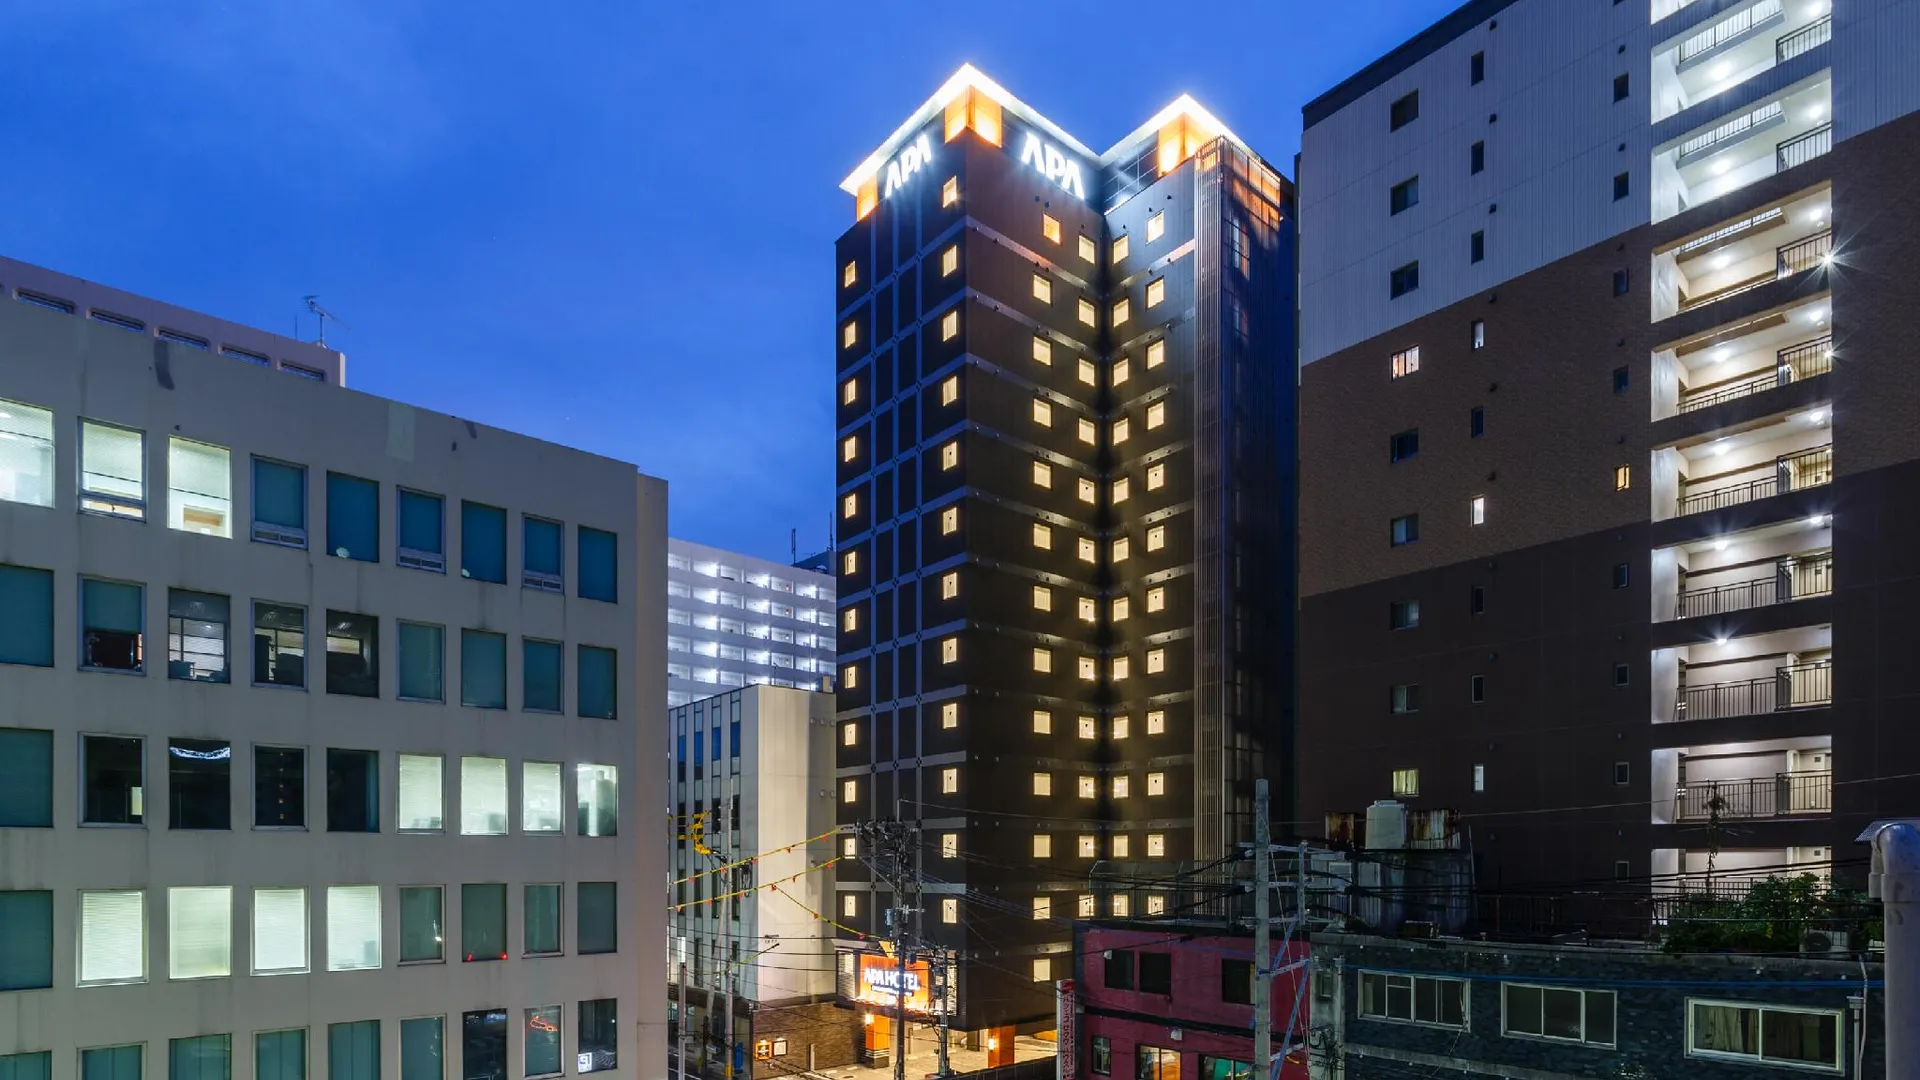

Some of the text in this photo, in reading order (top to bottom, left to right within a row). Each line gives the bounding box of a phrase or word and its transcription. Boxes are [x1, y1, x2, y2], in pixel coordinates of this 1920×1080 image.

[884, 133, 932, 198] APA
[1021, 132, 1085, 200] APA
[864, 968, 884, 985] APA
